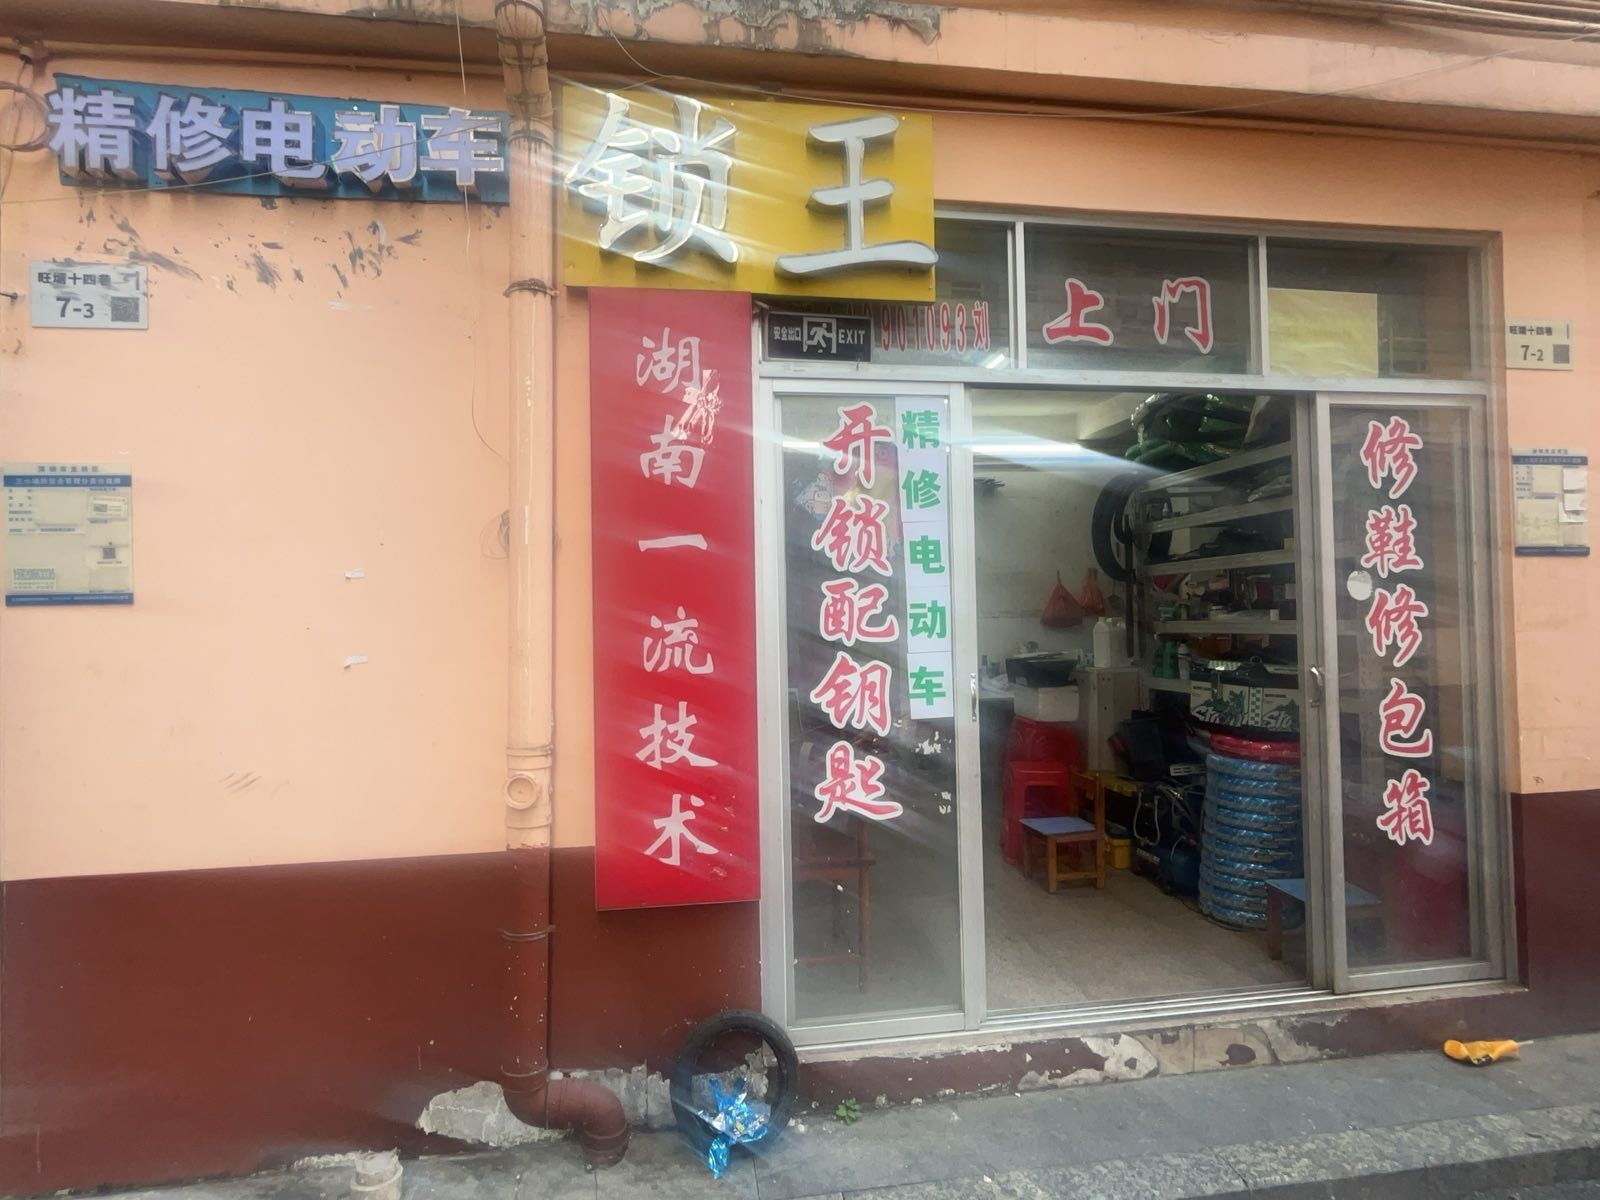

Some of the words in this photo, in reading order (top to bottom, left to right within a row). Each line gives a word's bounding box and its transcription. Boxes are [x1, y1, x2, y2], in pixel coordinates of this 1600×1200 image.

[47, 87, 504, 187] 精修电动车
[566, 92, 939, 276] 锁王
[56, 296, 95, 319] 7-3
[773, 325, 802, 342] 安全出口
[838, 328, 866, 345] EXIT
[1042, 277, 1214, 354] 上门
[1520, 344, 1545, 362] 7-2
[634, 326, 719, 867] 湖南一流技术
[810, 401, 904, 824] 开锁配钥匙
[901, 409, 948, 706] 精修电动车
[1360, 415, 1435, 847] 修鞋修包箱
